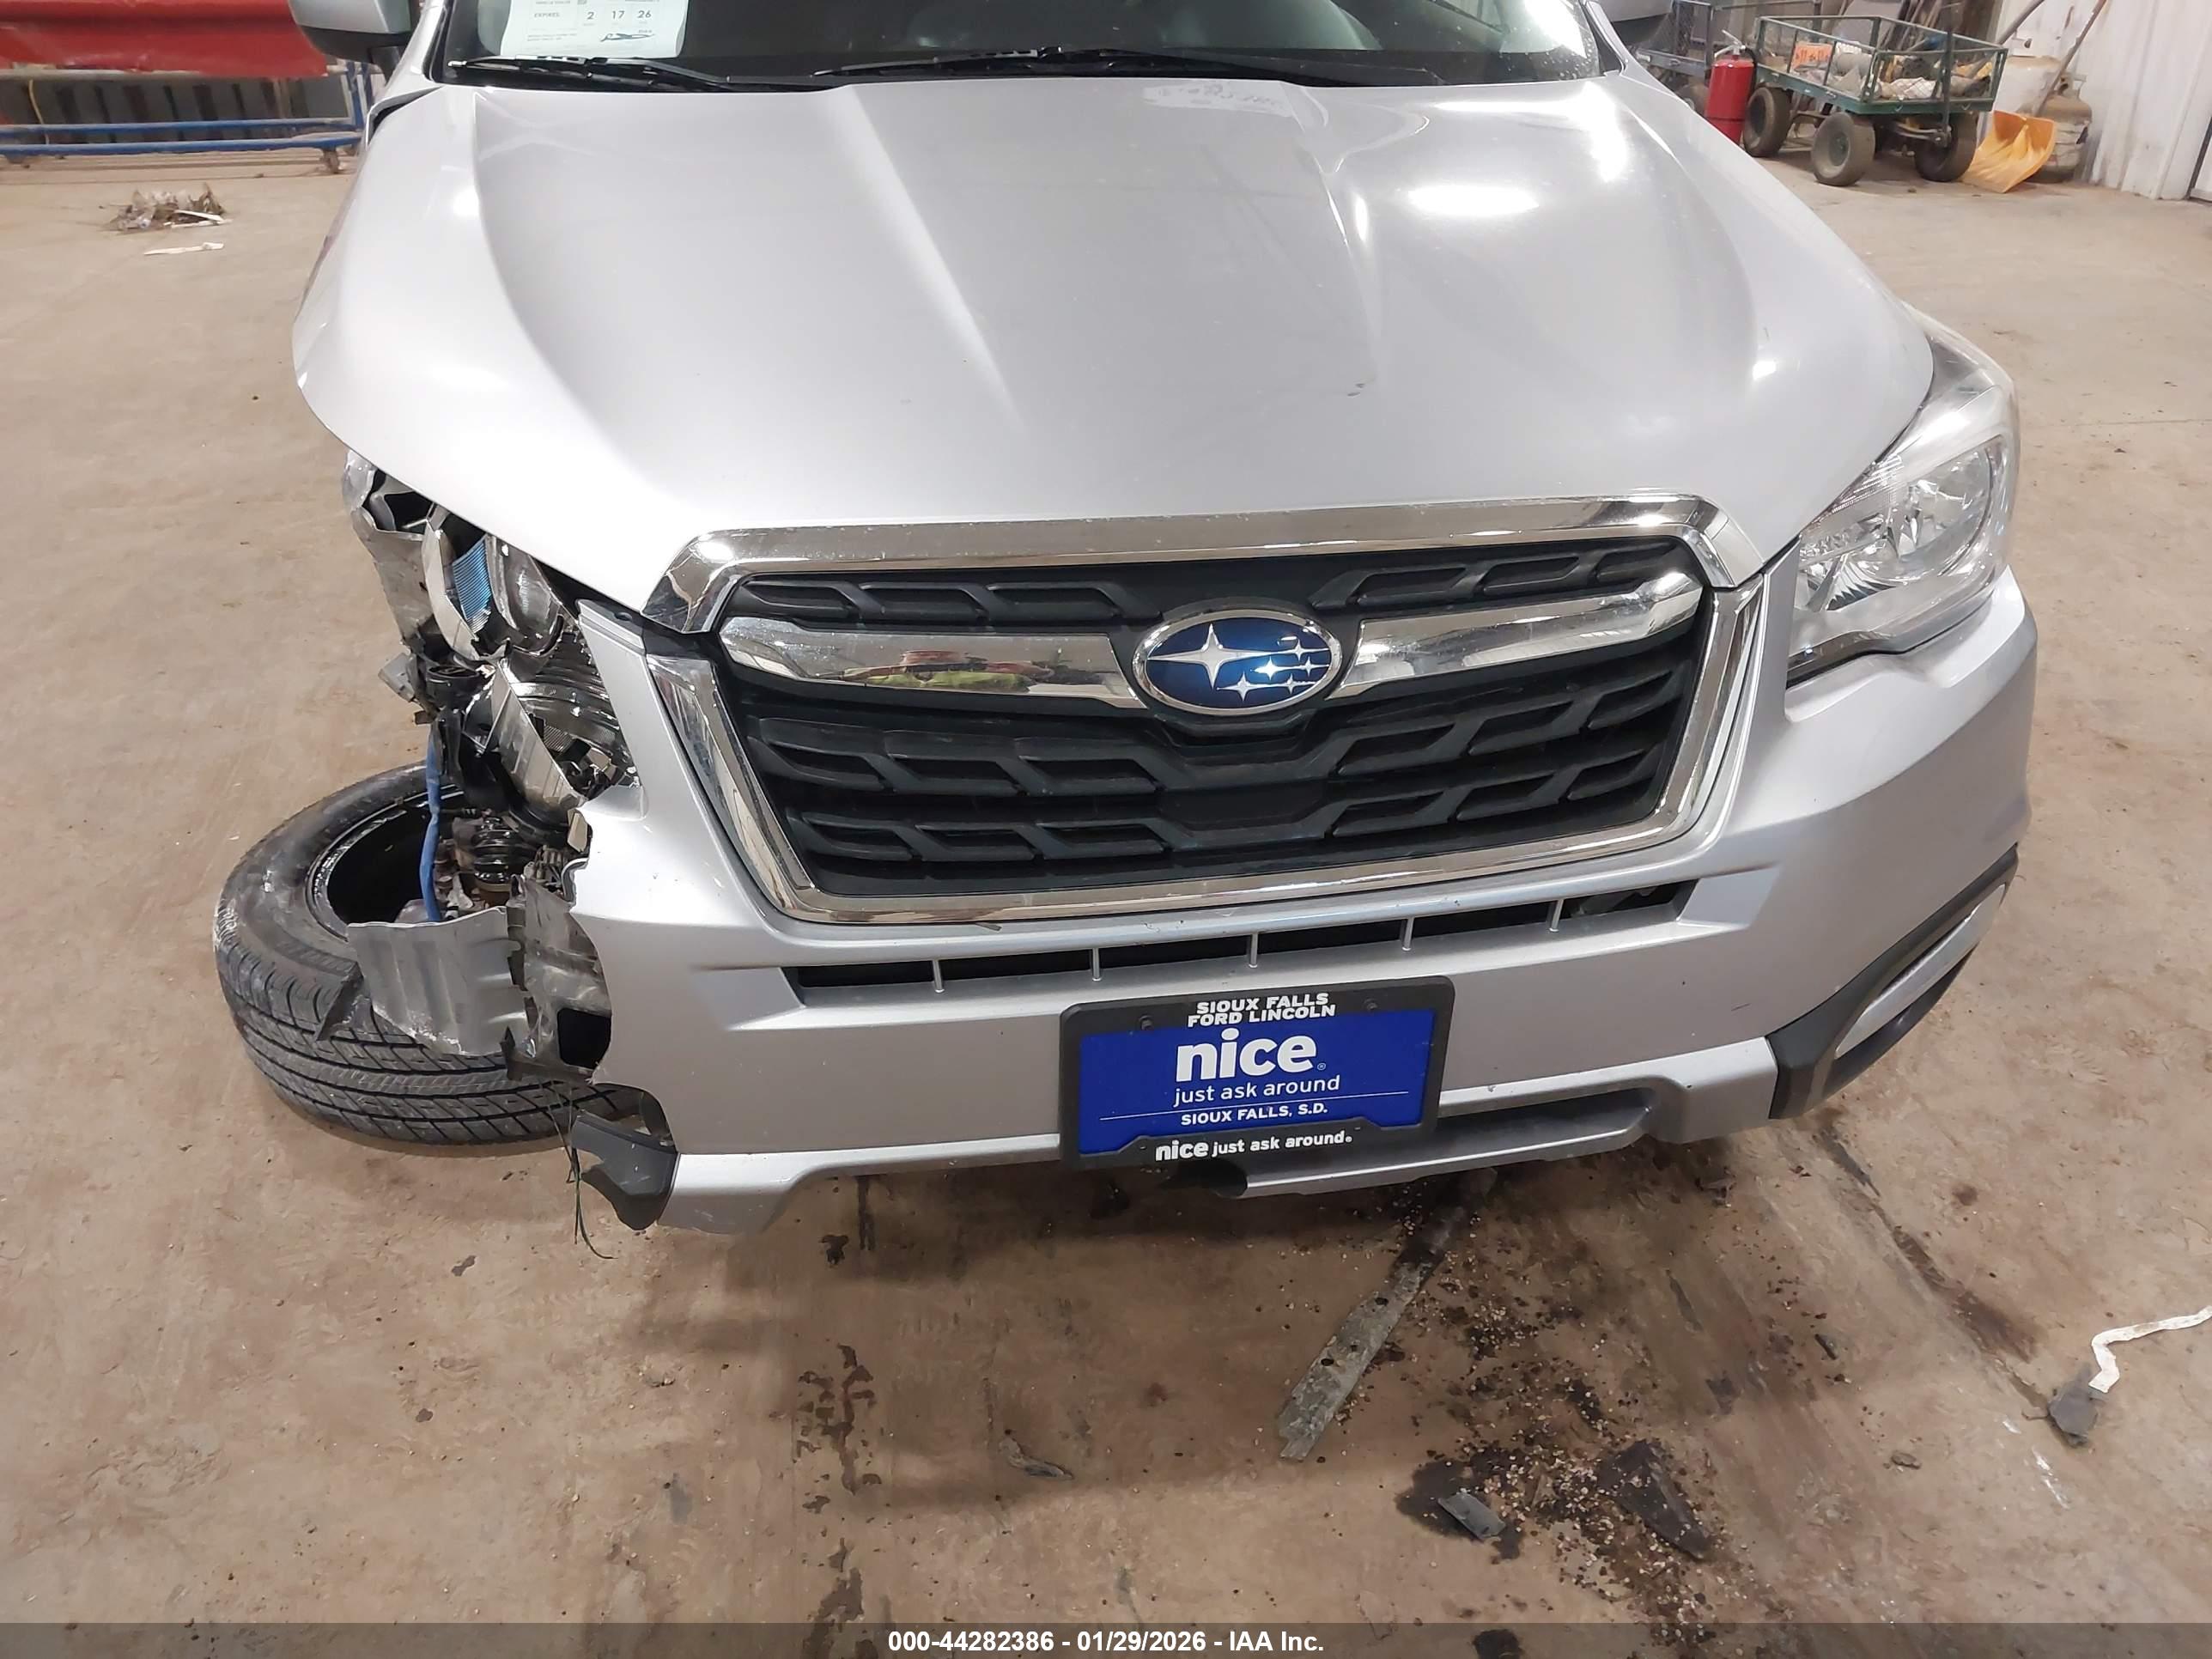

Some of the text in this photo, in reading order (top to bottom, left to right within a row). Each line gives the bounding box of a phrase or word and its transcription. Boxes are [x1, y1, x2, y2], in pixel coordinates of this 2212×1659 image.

[586, 11, 595, 21] 2
[611, 10, 625, 19] 17
[1196, 992, 1329, 1015] SIOUX FALLS
[1188, 1004, 1336, 1028] FORD LINCOLN
[1173, 1074, 1340, 1108] just ask around
[1181, 1103, 1328, 1126] SIOUX FALLS, S.D.
[1155, 1139, 1209, 1161] nice
[1212, 1139, 1245, 1158] just
[1249, 1136, 1280, 1152] ask
